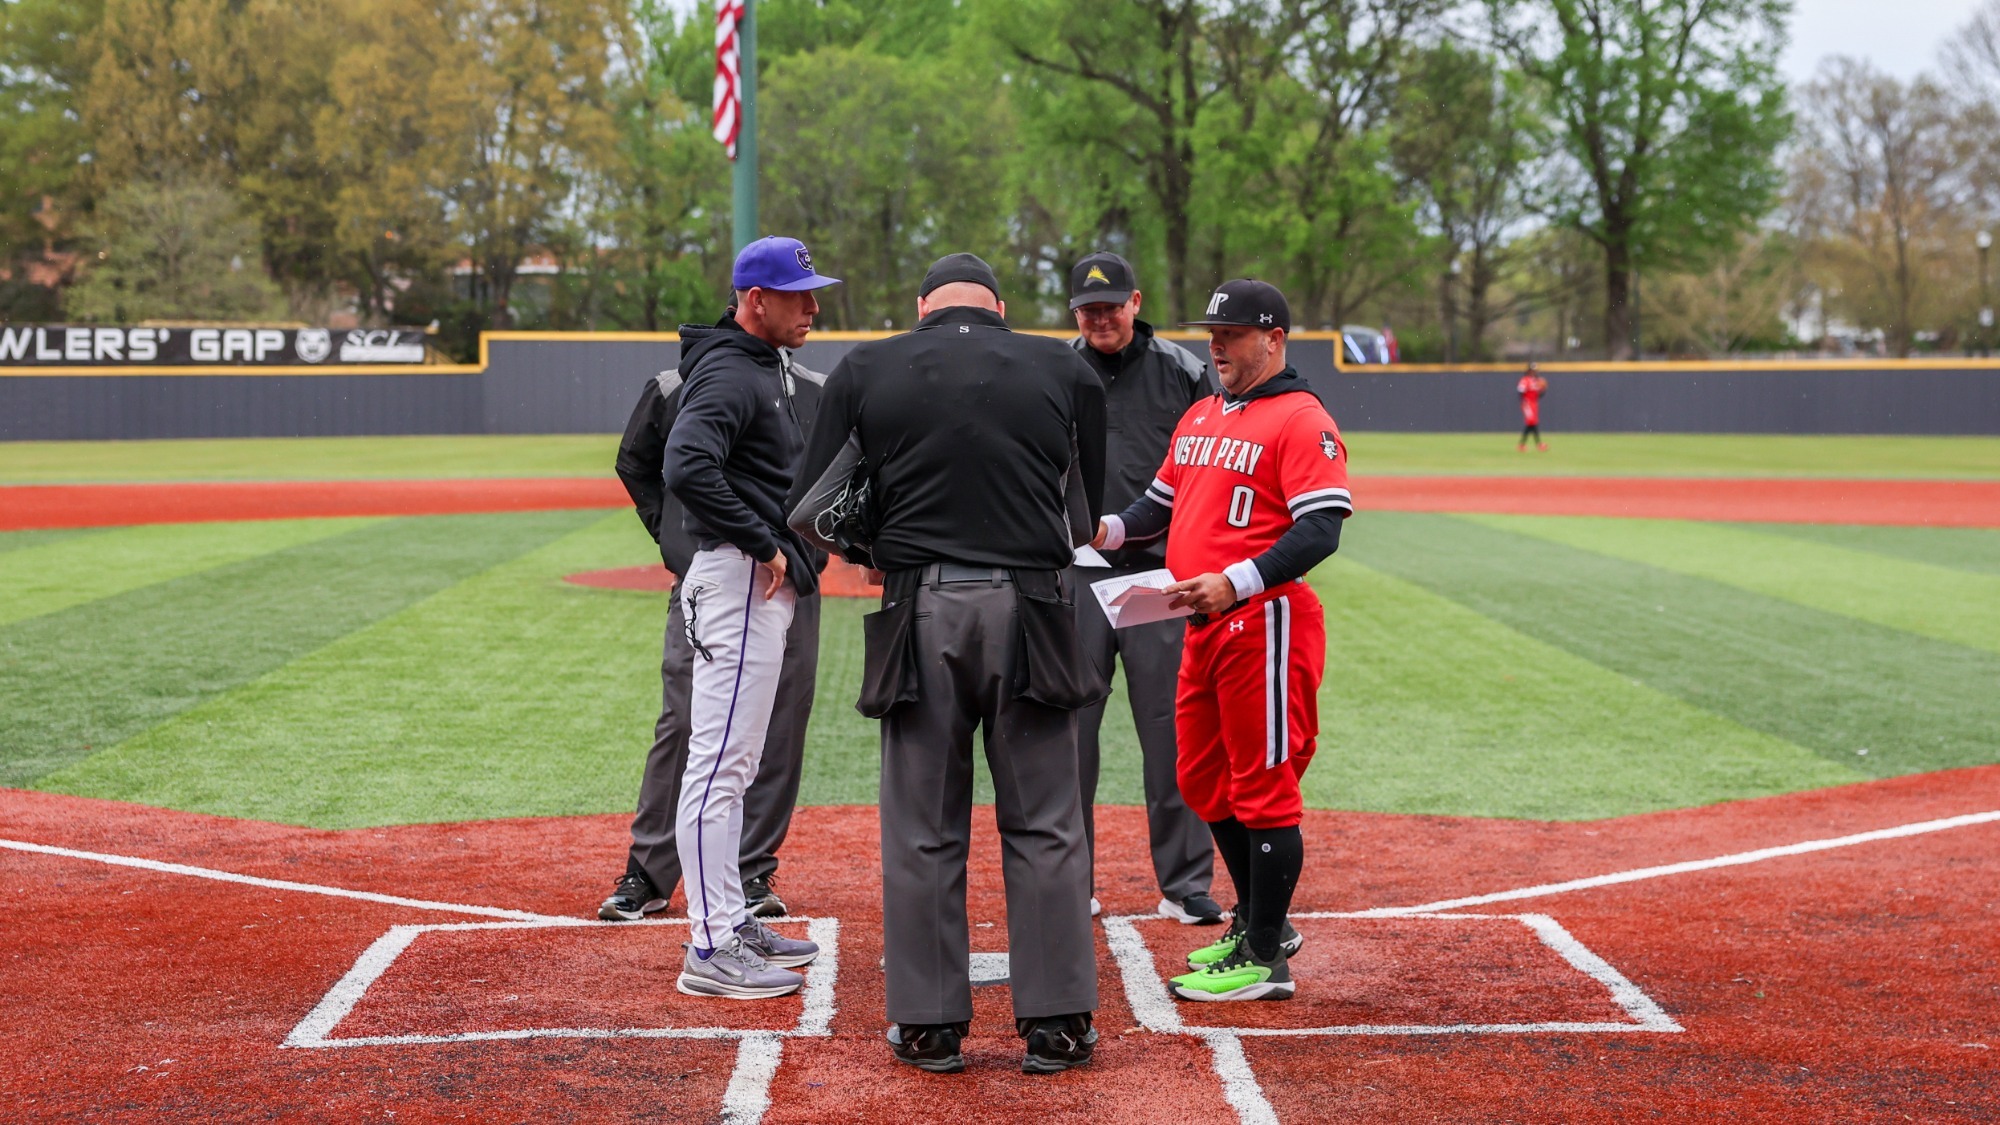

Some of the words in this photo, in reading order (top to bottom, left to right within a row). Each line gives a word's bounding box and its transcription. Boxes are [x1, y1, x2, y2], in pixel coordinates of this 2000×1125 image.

[190, 329, 285, 361] GAP
[959, 325, 970, 334] S
[1212, 436, 1264, 476] PEAY
[1227, 485, 1255, 527] 0
